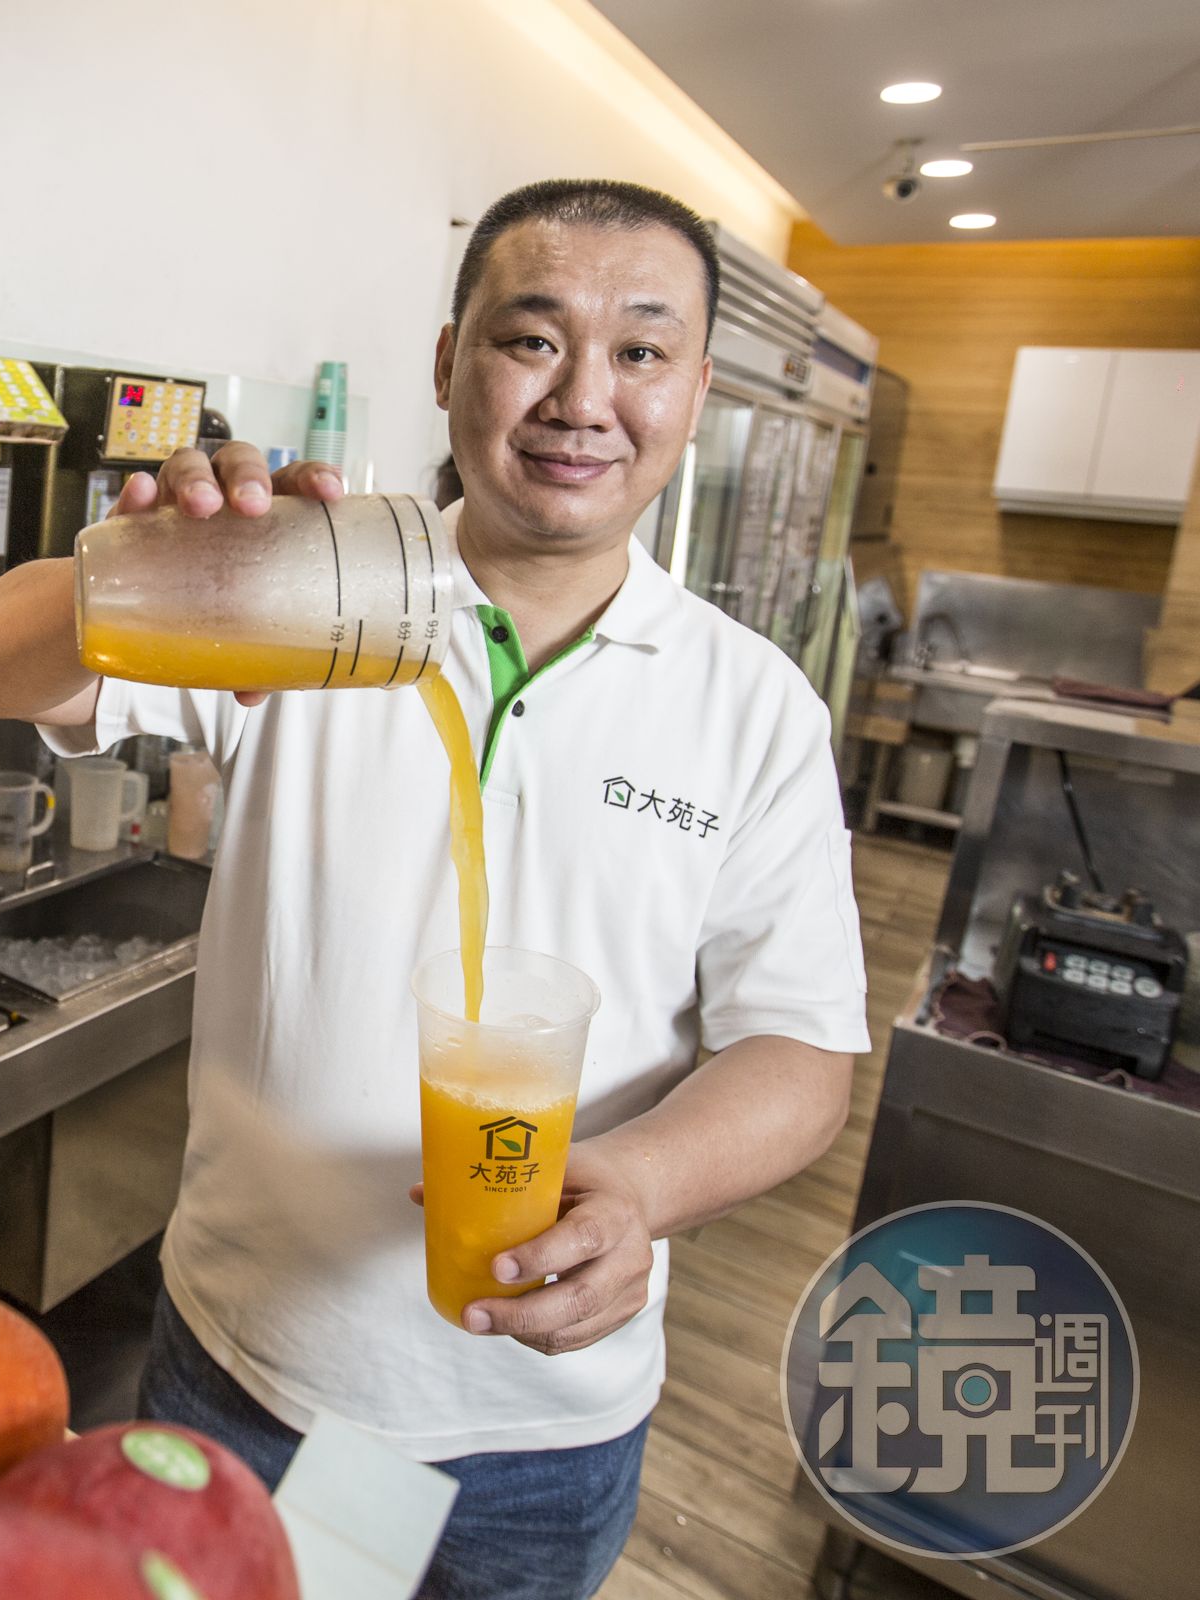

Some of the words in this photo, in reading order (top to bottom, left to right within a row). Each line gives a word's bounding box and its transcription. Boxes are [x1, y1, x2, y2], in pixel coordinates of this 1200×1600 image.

[397, 621, 412, 641] 8分
[425, 620, 439, 639] 9分
[637, 789, 720, 839] 大苑子
[469, 1162, 541, 1185] 大苑子
[484, 1185, 508, 1193] SINCE
